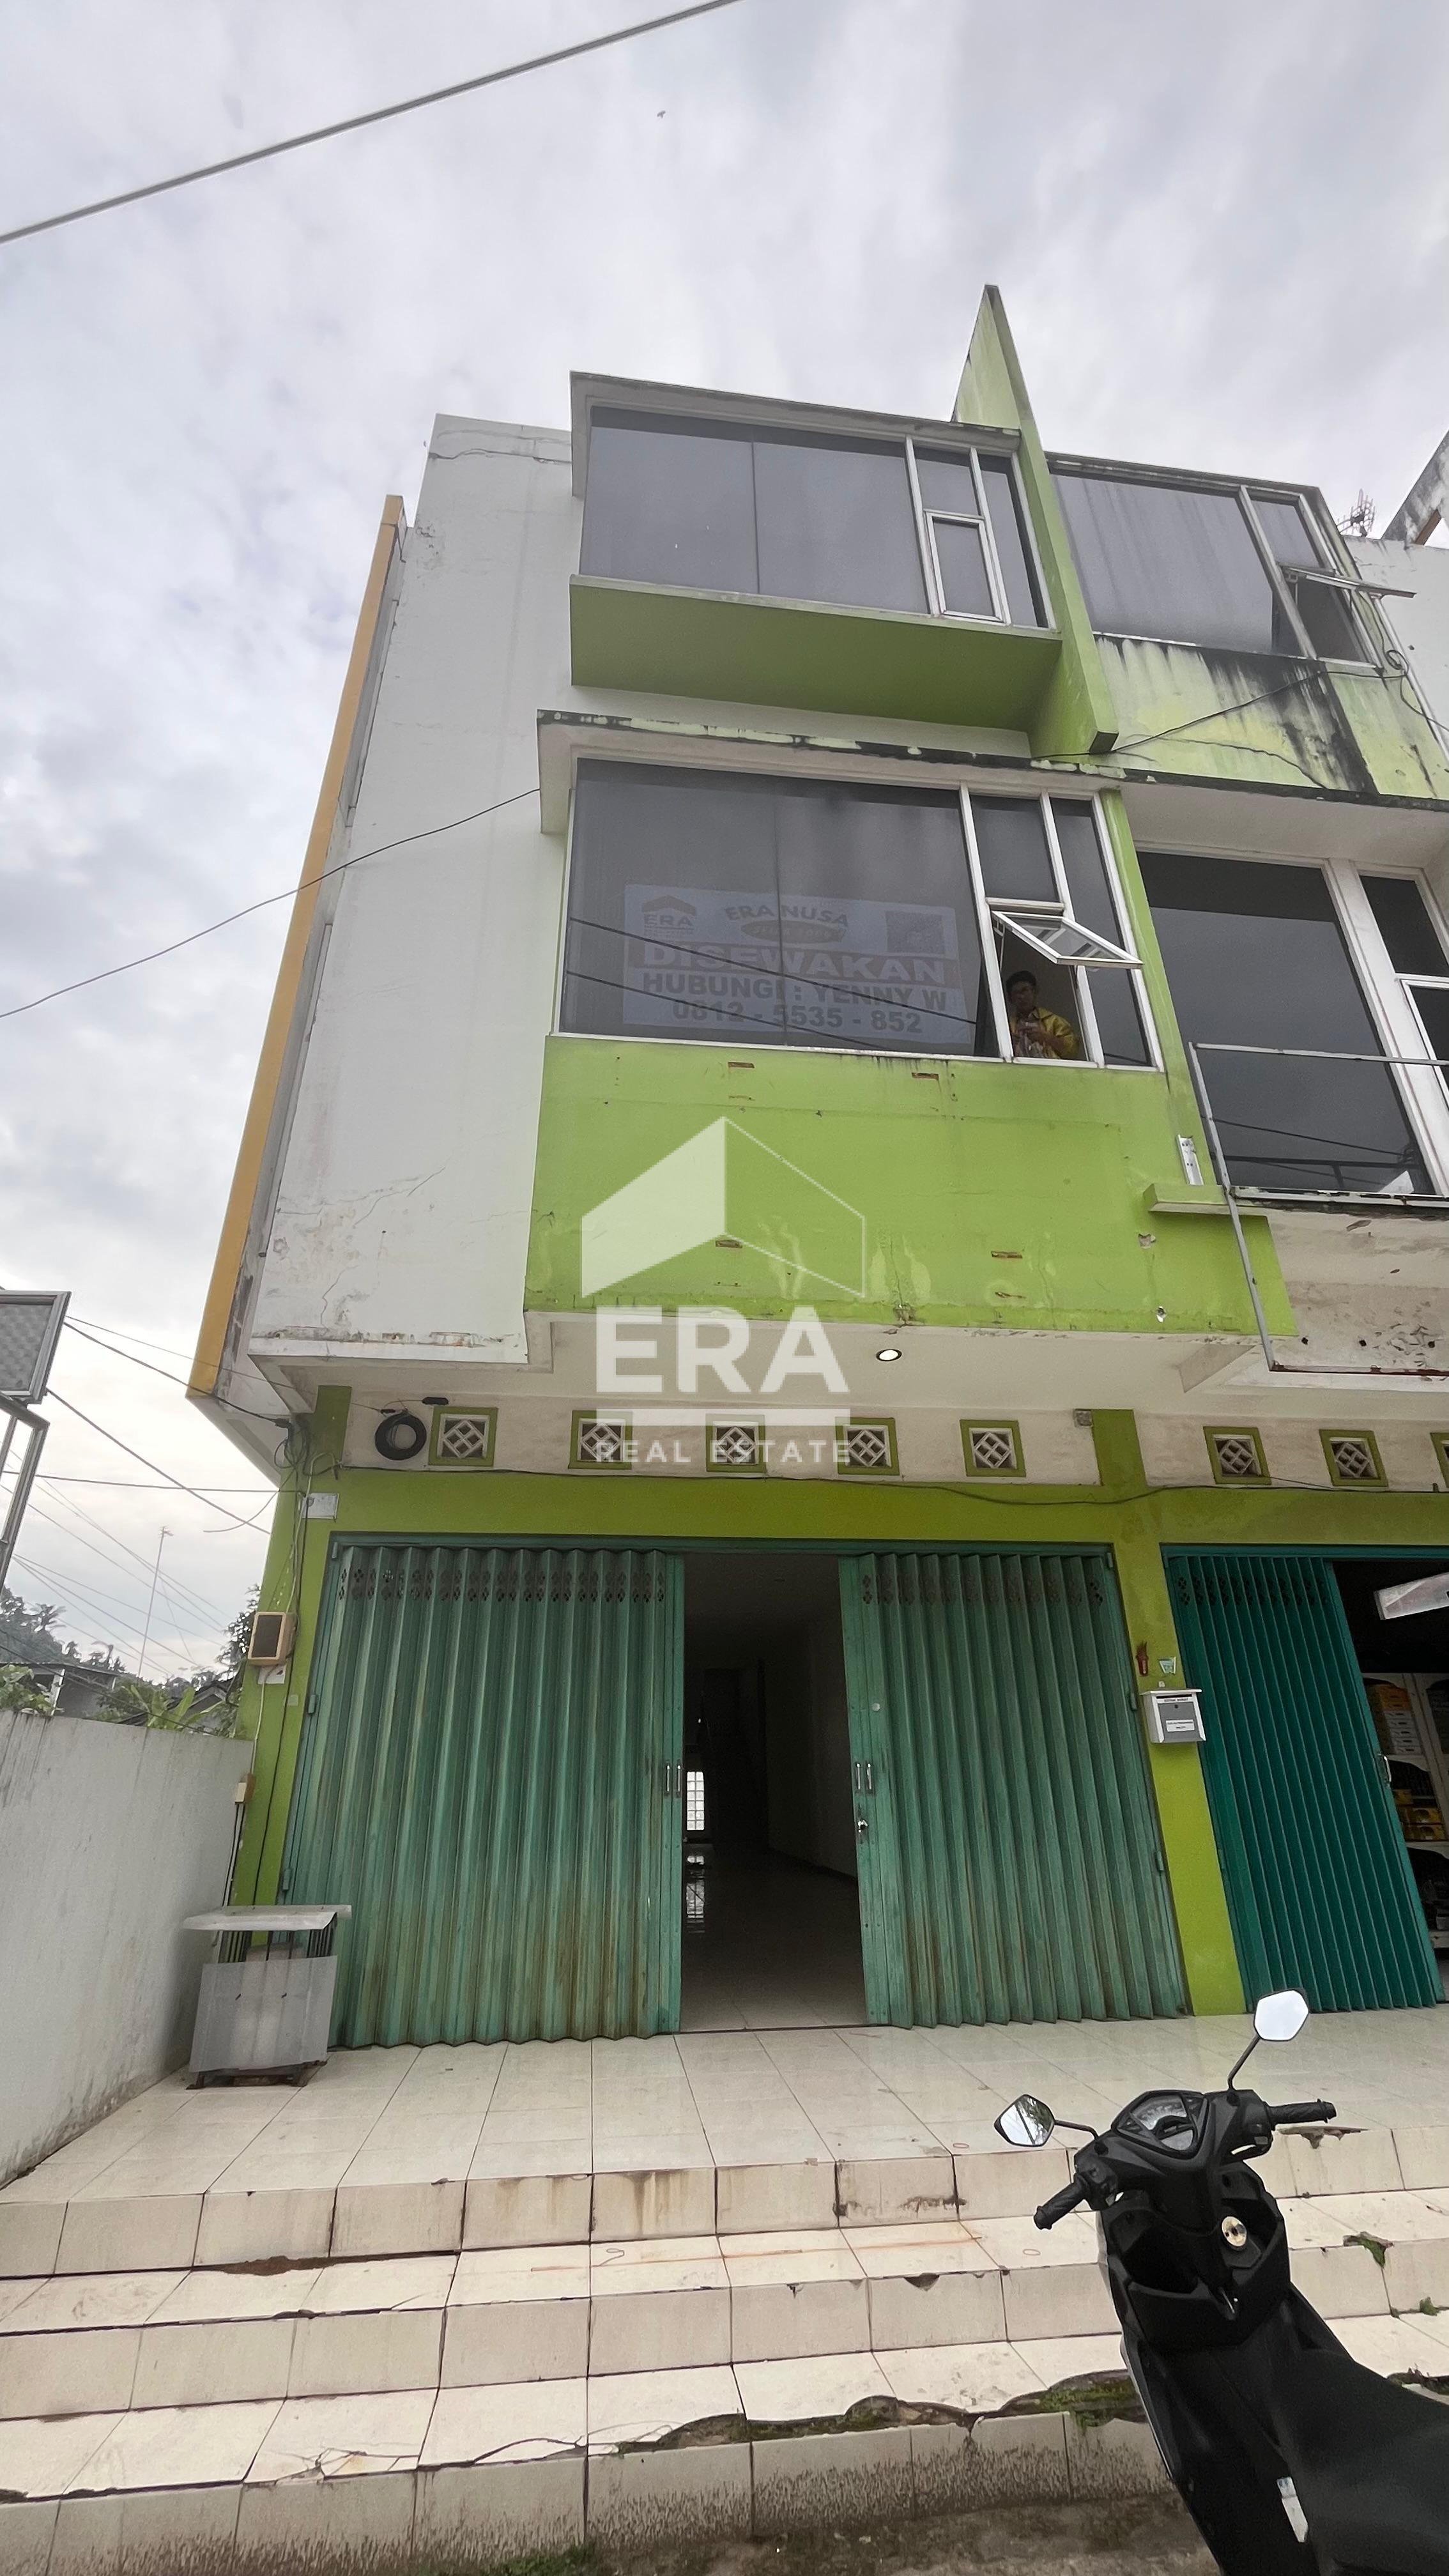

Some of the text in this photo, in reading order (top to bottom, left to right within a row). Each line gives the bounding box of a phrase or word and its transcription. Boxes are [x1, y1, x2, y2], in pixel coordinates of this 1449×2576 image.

[644, 914, 694, 926] ERA
[725, 905, 848, 927] ERA NUSA
[645, 945, 946, 985] DISEWAKAN
[643, 972, 785, 1000] HUBUNGI
[813, 984, 913, 1008] YENNY
[922, 990, 947, 1011] W
[673, 999, 744, 1023] 0812
[773, 1004, 843, 1028] 5535
[871, 1009, 923, 1034] 852
